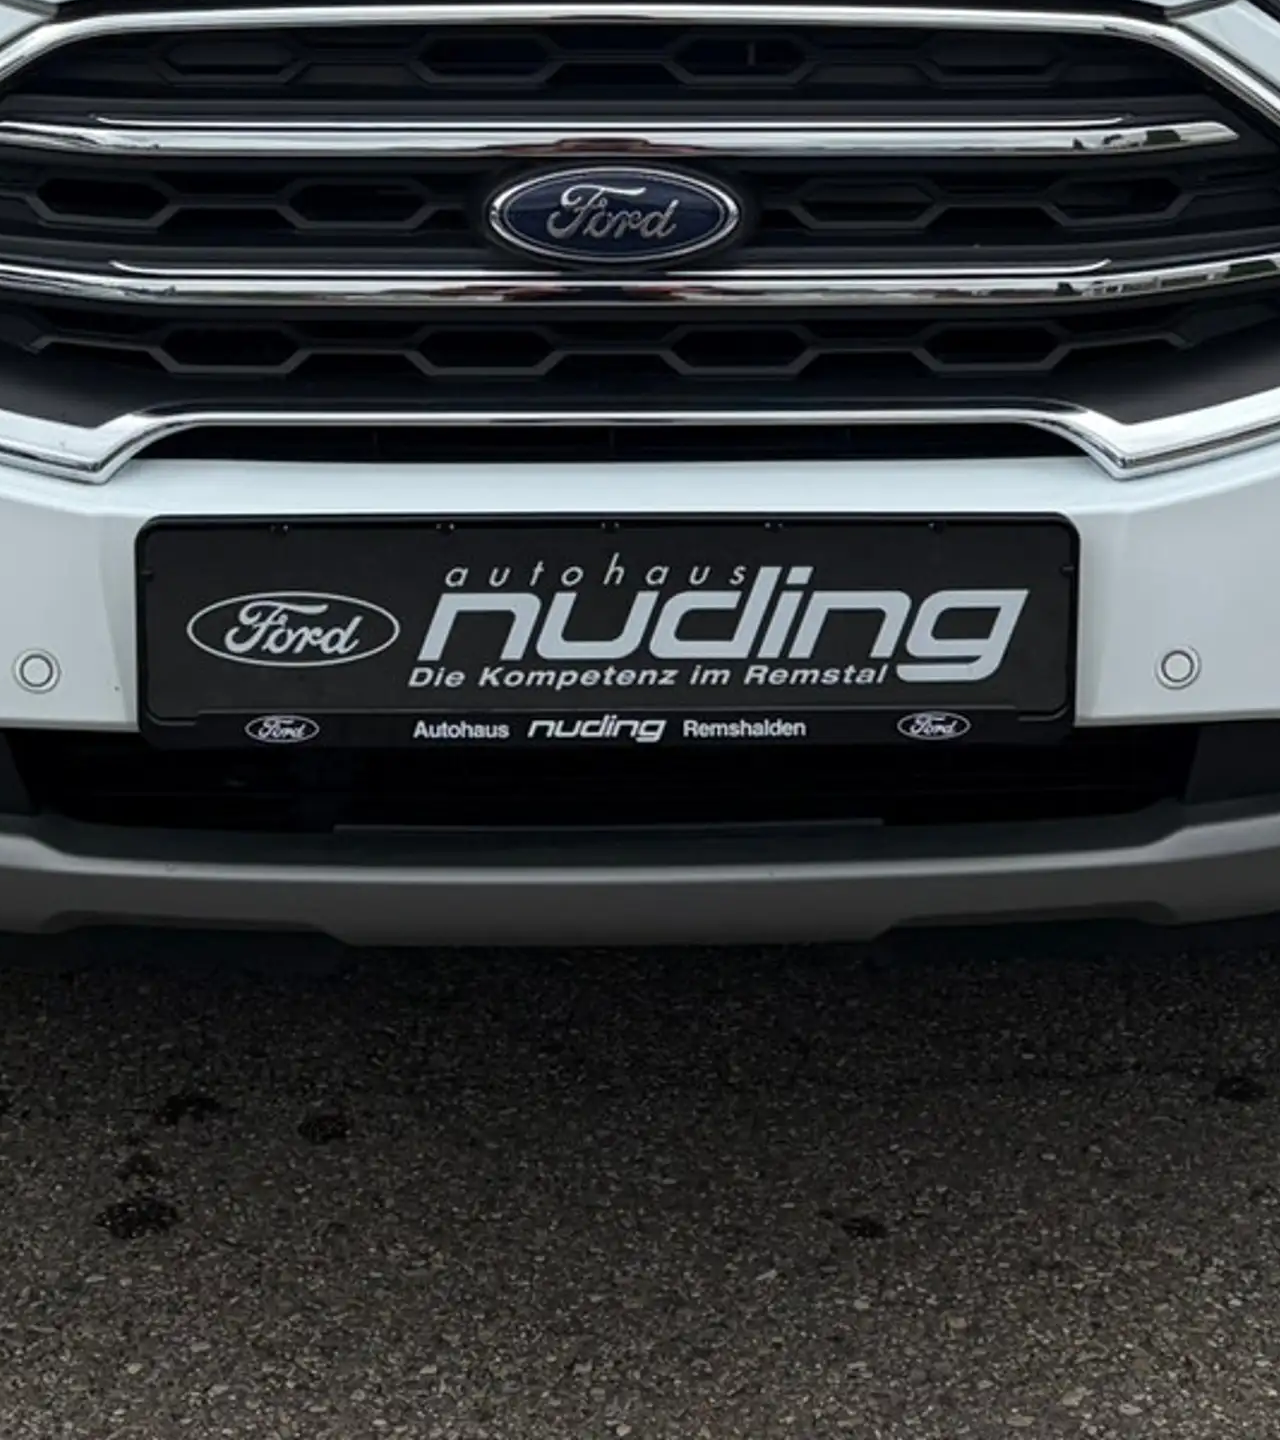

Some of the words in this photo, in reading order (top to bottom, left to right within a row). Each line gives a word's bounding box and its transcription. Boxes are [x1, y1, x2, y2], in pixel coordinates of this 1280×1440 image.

[546, 183, 680, 239] Ford
[445, 552, 746, 588] autohaus
[224, 600, 363, 655] Ford
[417, 566, 1029, 682] nuding
[408, 666, 466, 688] Die
[478, 665, 679, 691] Kompetenz
[689, 664, 731, 685] im
[743, 663, 889, 685] Remstal
[413, 720, 510, 739] Autohaus
[527, 714, 667, 743] nuding
[683, 718, 807, 738] Remshalden
